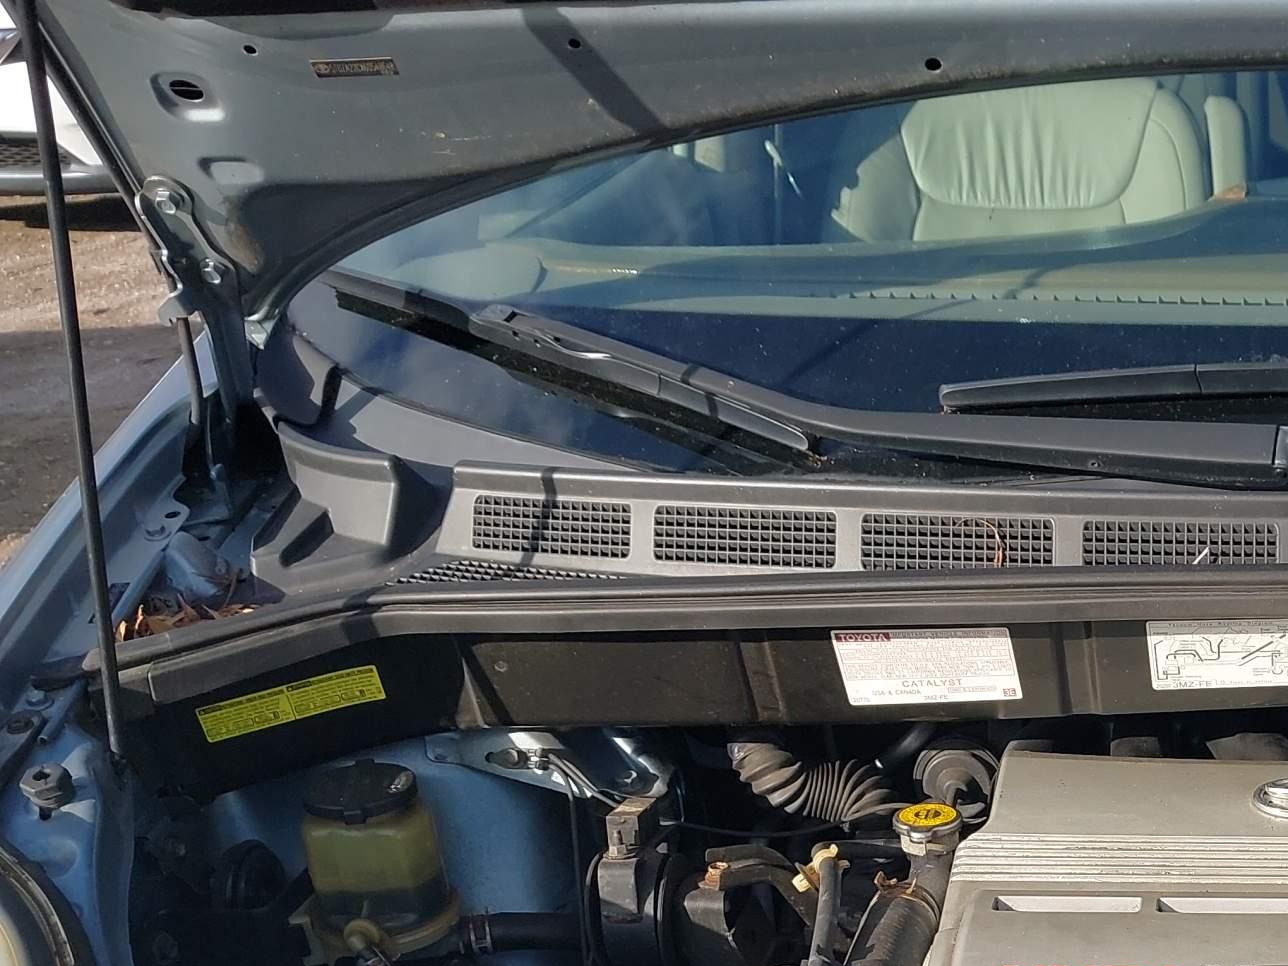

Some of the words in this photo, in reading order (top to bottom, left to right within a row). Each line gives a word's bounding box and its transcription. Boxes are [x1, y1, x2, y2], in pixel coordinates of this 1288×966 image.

[839, 633, 888, 642] TOYOTA
[902, 678, 962, 688] CATALYST
[1172, 680, 1213, 688] 3MZ-FE
